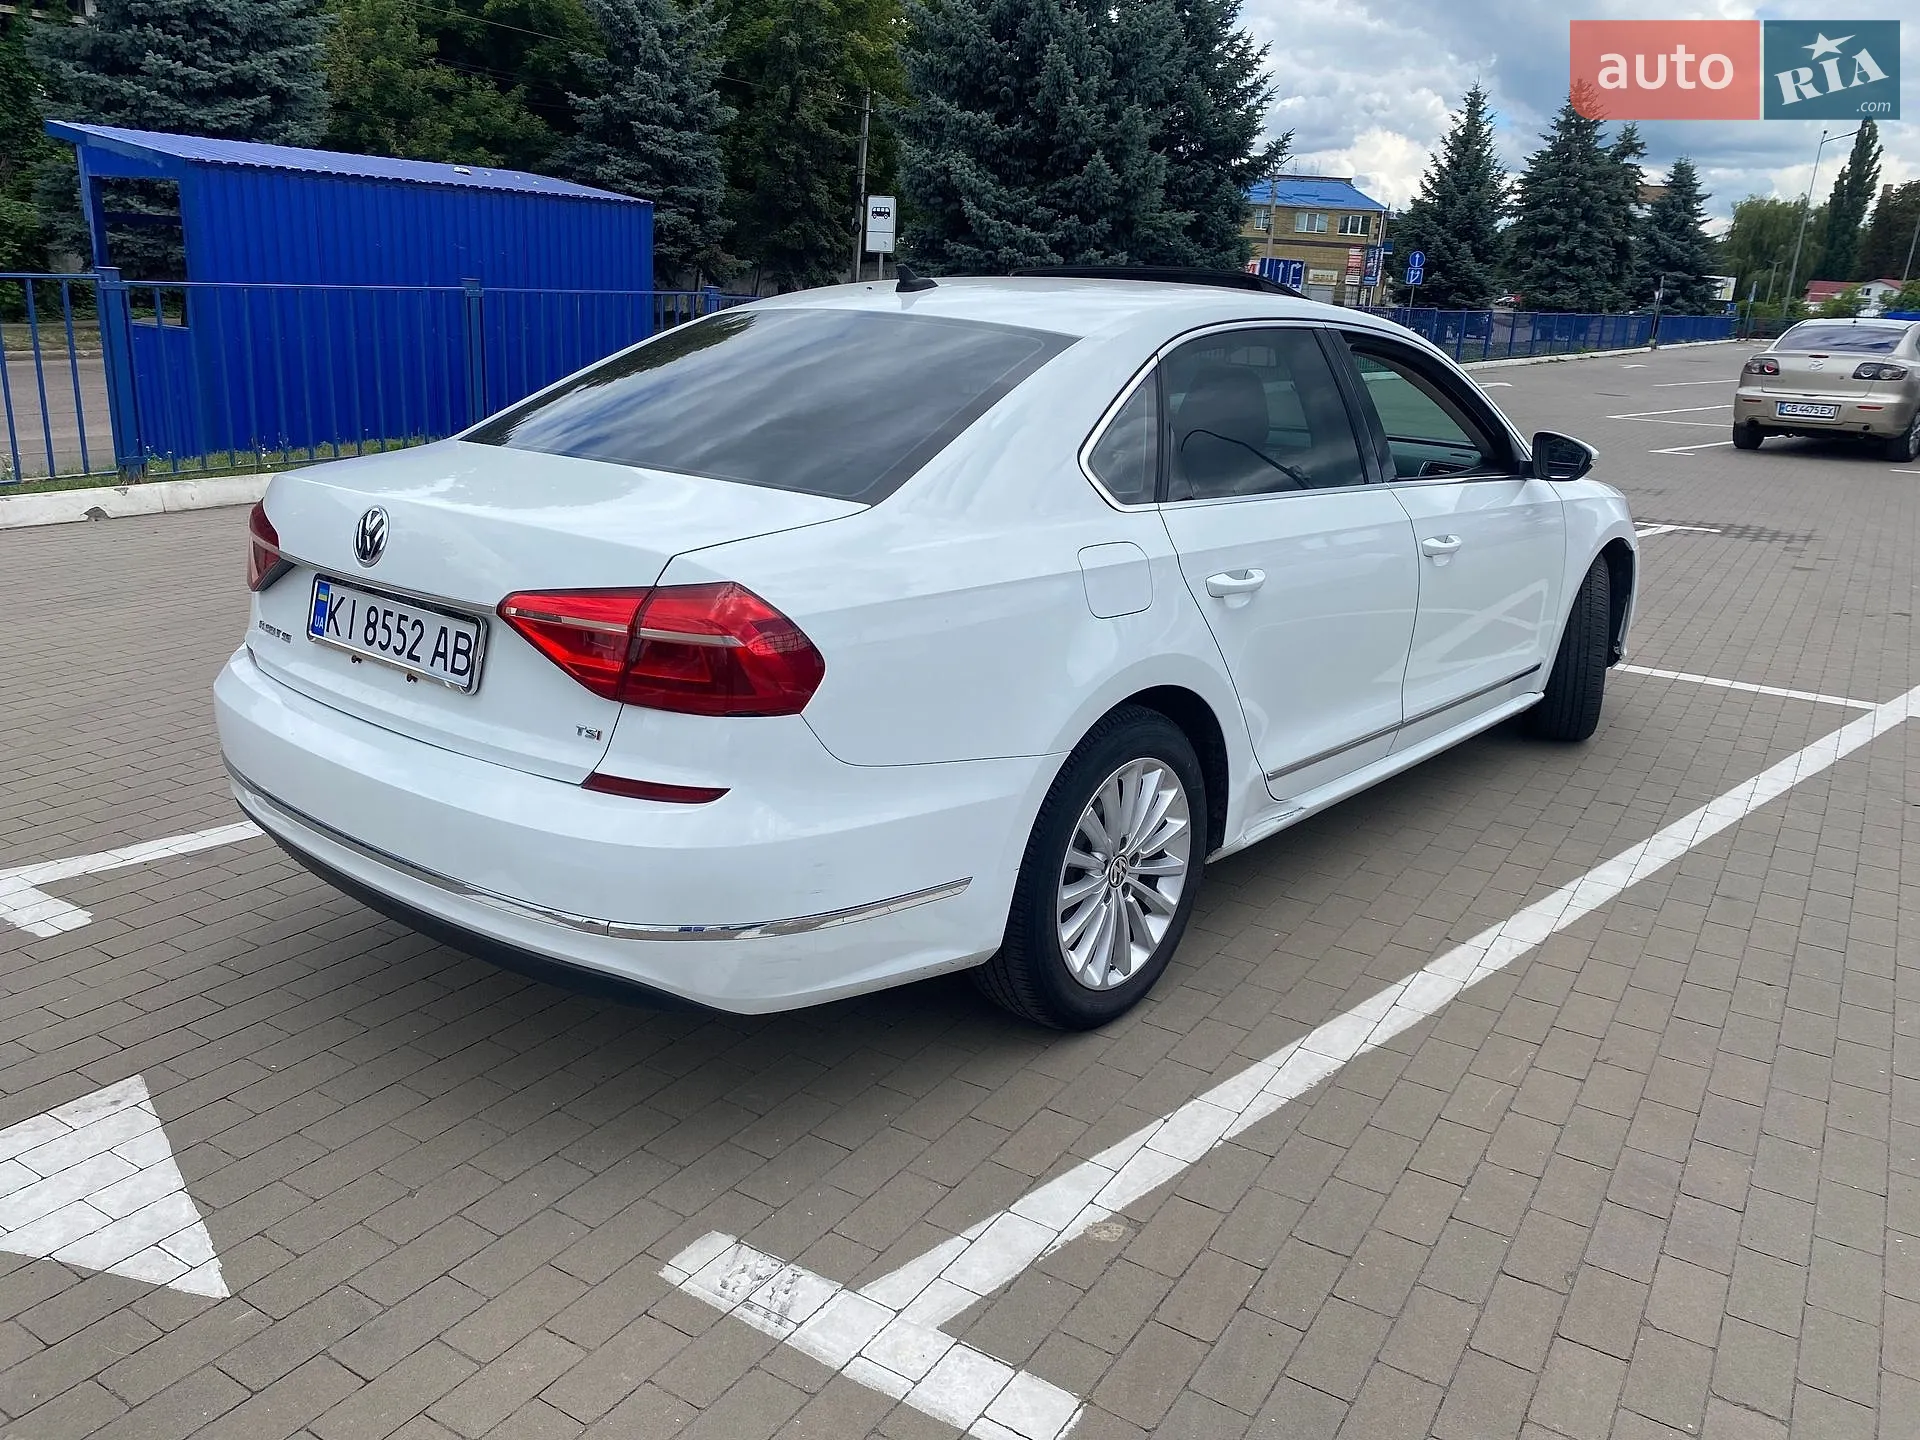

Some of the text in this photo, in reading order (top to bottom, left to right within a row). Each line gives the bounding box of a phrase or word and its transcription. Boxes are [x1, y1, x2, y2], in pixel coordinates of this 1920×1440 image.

[1819, 406, 1834, 415] EX
[314, 615, 325, 630] UA
[326, 592, 473, 677] KI 8552 AB
